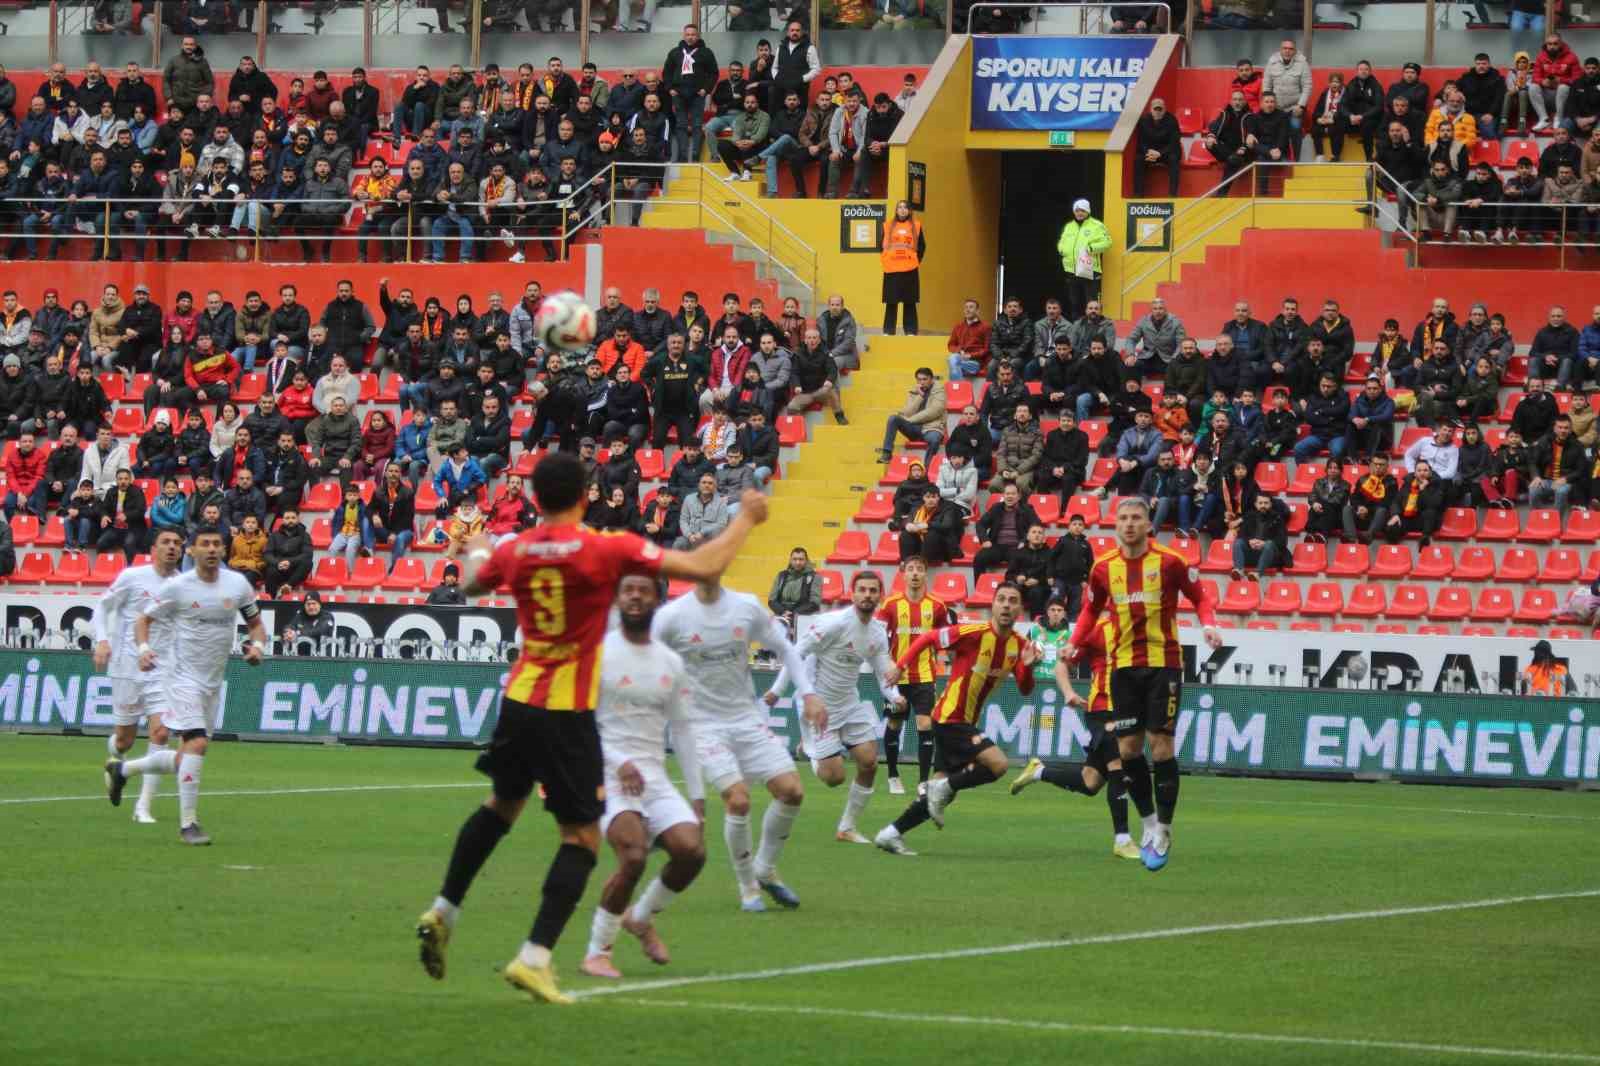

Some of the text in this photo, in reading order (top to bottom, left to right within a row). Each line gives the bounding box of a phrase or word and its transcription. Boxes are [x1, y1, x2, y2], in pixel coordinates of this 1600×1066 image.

[976, 57, 1149, 78] SPORUN KALB
[855, 224, 870, 242] E
[529, 567, 566, 636] 9
[259, 667, 508, 737] EMİNEV
